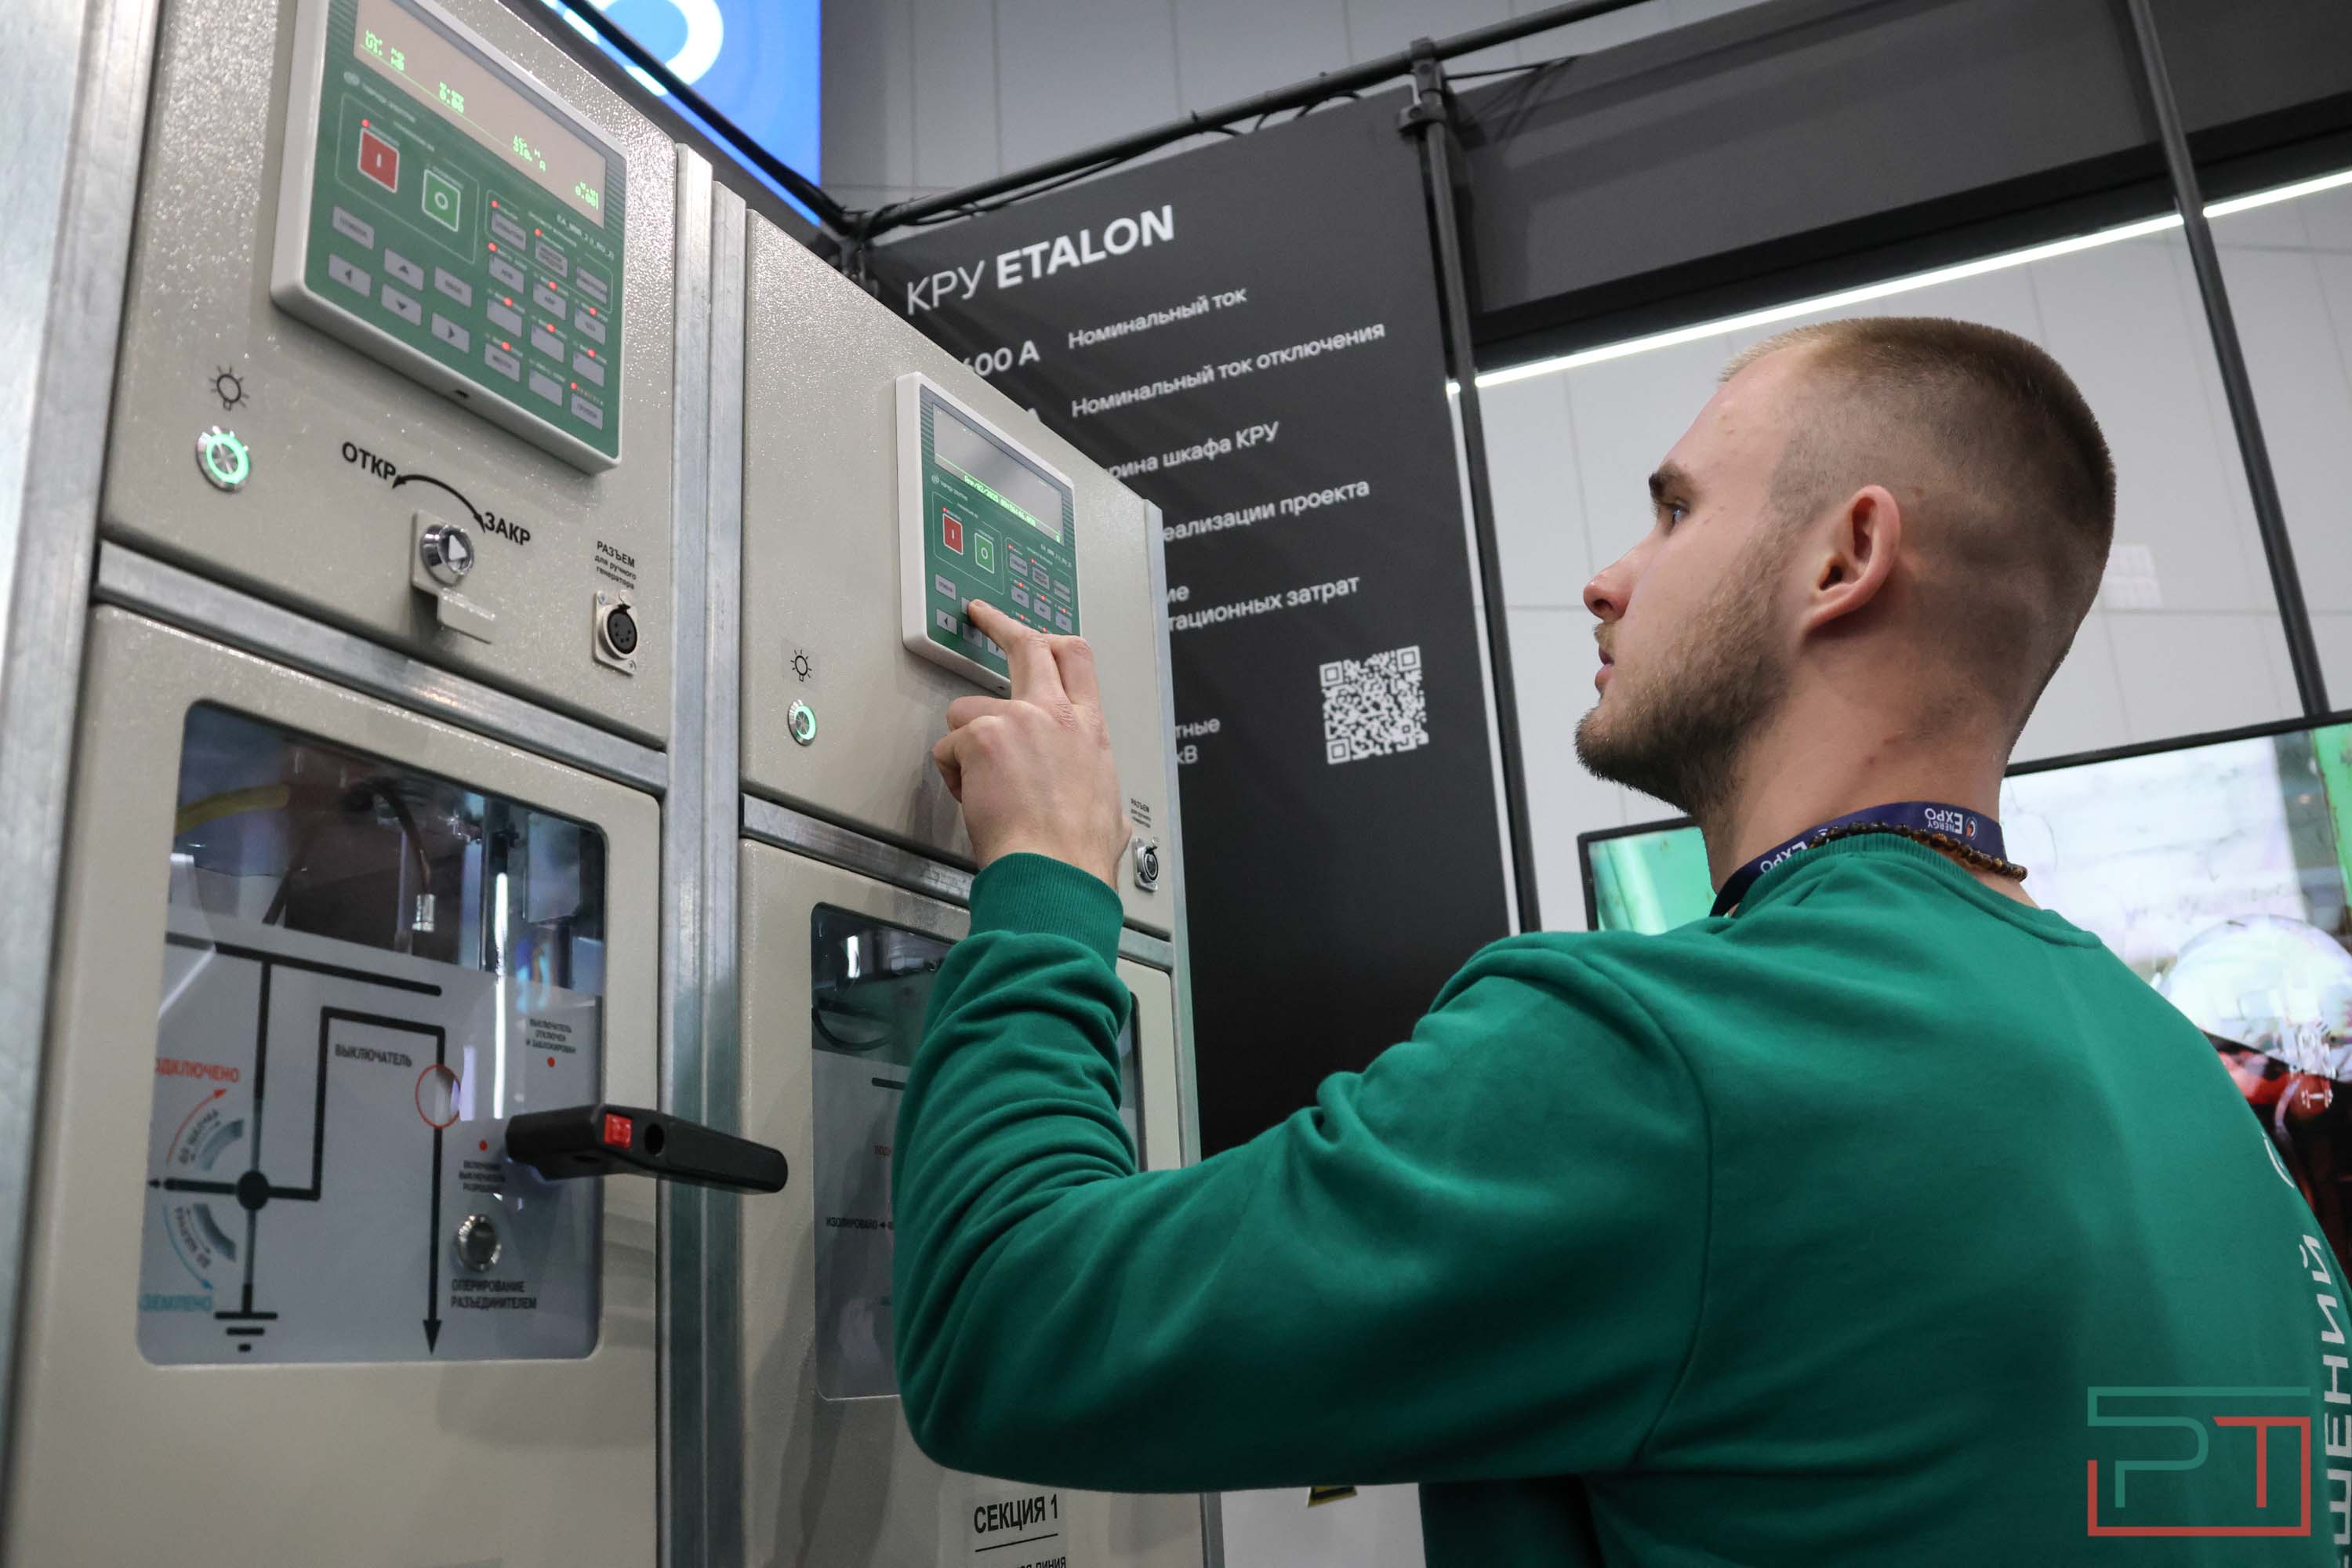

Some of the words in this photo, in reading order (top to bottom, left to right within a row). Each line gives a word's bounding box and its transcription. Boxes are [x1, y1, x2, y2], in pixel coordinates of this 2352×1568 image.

[907, 260, 985, 315] КРУ
[996, 205, 1175, 289] ETALON
[1068, 295, 1210, 350] Номинальный
[1211, 288, 1248, 309] ток
[1072, 365, 1215, 418] Номинальный
[1217, 358, 1253, 379] ток
[1255, 322, 1386, 369] отключения
[342, 441, 397, 482] ОТКР
[1103, 456, 1159, 479] рина
[1162, 437, 1232, 468] шкафа
[1236, 421, 1280, 449] КРУ
[484, 512, 532, 546] ЗАКР
[1163, 502, 1276, 543] еализации
[1279, 481, 1370, 517] проекта
[597, 540, 635, 568] РАЗЪЕМ
[1168, 593, 1283, 632] тационных
[1286, 576, 1360, 607] затрат
[1174, 718, 1221, 739] тные
[335, 1044, 412, 1068] ВЫКЛЮЧАТЕЛЬ
[974, 1496, 1046, 1534] СЕКЦИЯ
[1051, 1493, 1058, 1519] 1
